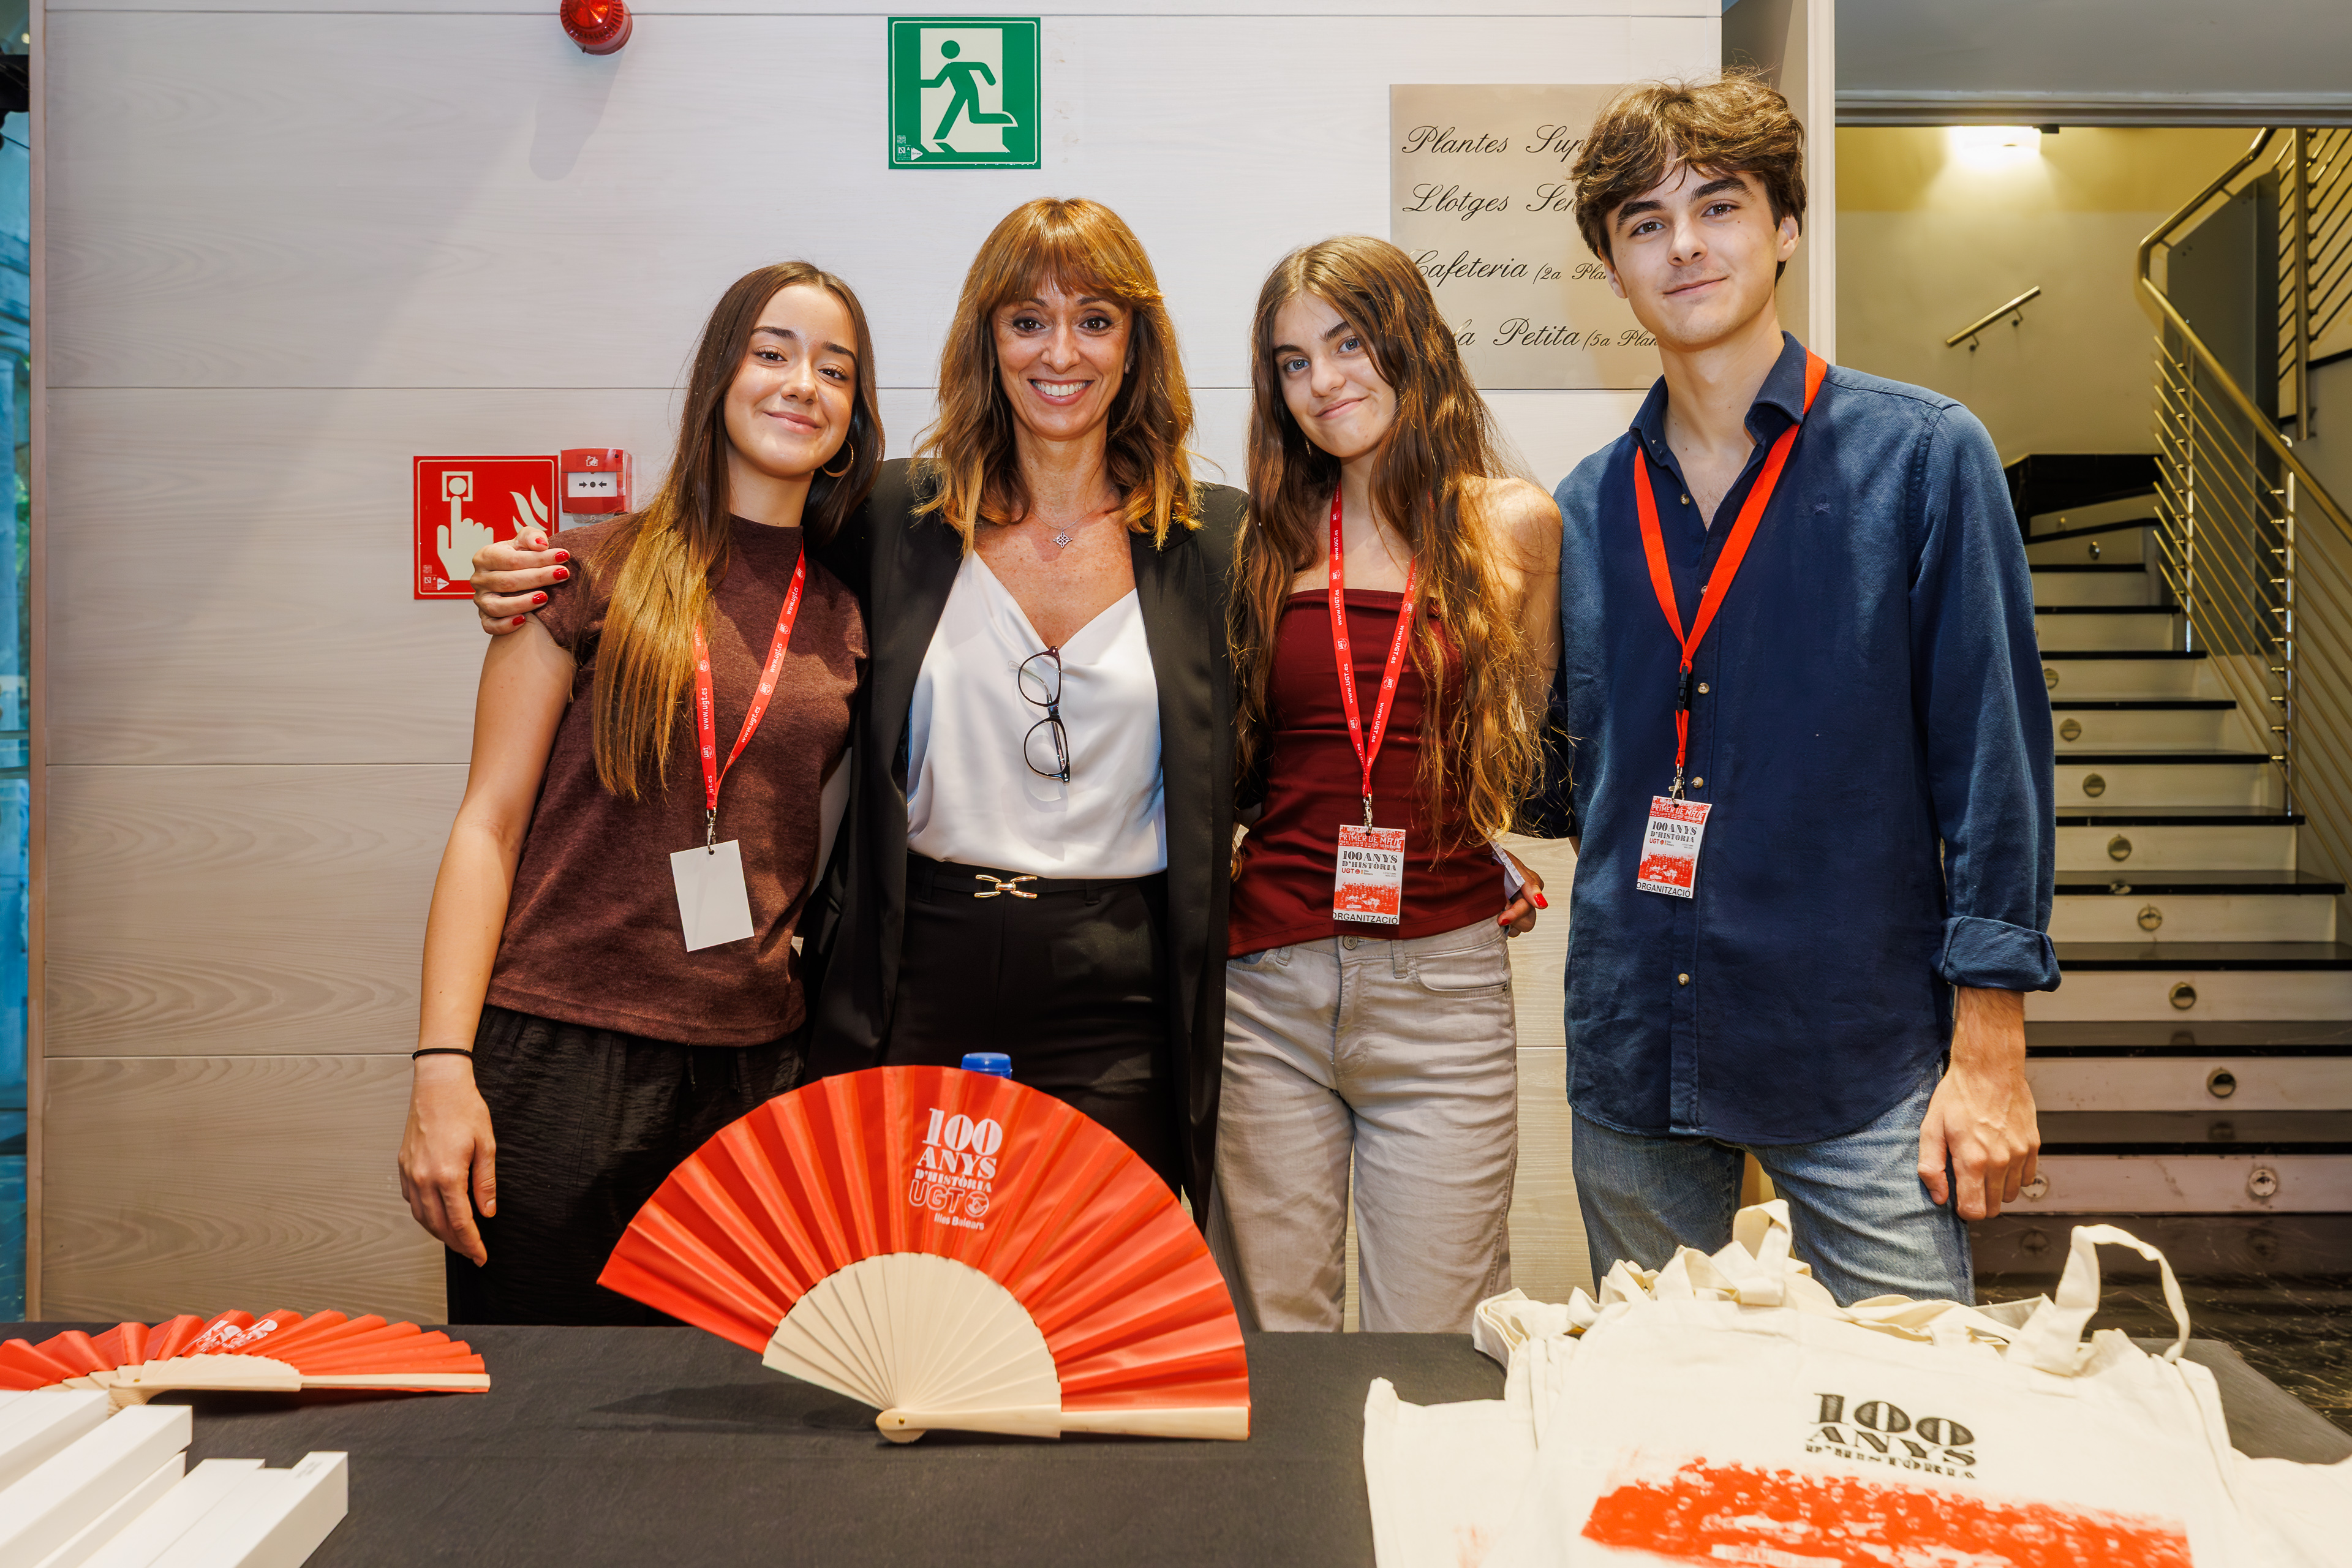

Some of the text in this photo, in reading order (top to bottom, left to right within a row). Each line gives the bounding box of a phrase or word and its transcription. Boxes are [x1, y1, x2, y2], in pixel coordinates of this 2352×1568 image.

[1401, 124, 1585, 163] Plantes Sup
[1402, 183, 1509, 221] Llotges
[1414, 250, 1528, 287] Cafeteria
[1532, 262, 1562, 284] (2a
[1493, 317, 1580, 346] Petita
[1581, 329, 1611, 351] (5a
[1617, 330, 1658, 347] Plan
[786, 586, 799, 616] www.ugt.es
[1334, 589, 1343, 626] www.UGT.es
[769, 643, 783, 673] www.ugt.es
[1390, 625, 1405, 665] www.UGT.es
[1343, 663, 1354, 704] www.UGT.es
[701, 687, 710, 730] www.ugt.es
[741, 706, 761, 743] www.ugt.es
[1371, 703, 1384, 743] www.UGT.es
[1339, 833, 1366, 842] PRIMER
[1650, 831, 1694, 843] D'HISTÒRIA
[1652, 821, 1697, 835] 100 ANYS
[1342, 861, 1396, 871] D'HISTÒRIA
[1343, 851, 1398, 864] 100 ANYS
[1636, 882, 1691, 897] ORGANITZACIÓ
[1333, 912, 1398, 924] ORGANITZACIÓ
[922, 1107, 1003, 1156] 100
[917, 1146, 997, 1180] ANYS
[909, 1179, 965, 1214] UGT
[914, 1169, 992, 1193] D'HISTÒRIA
[934, 1212, 985, 1231] Illes Balears
[1808, 1393, 1975, 1446] 100
[1804, 1426, 1977, 1466] ANYS
